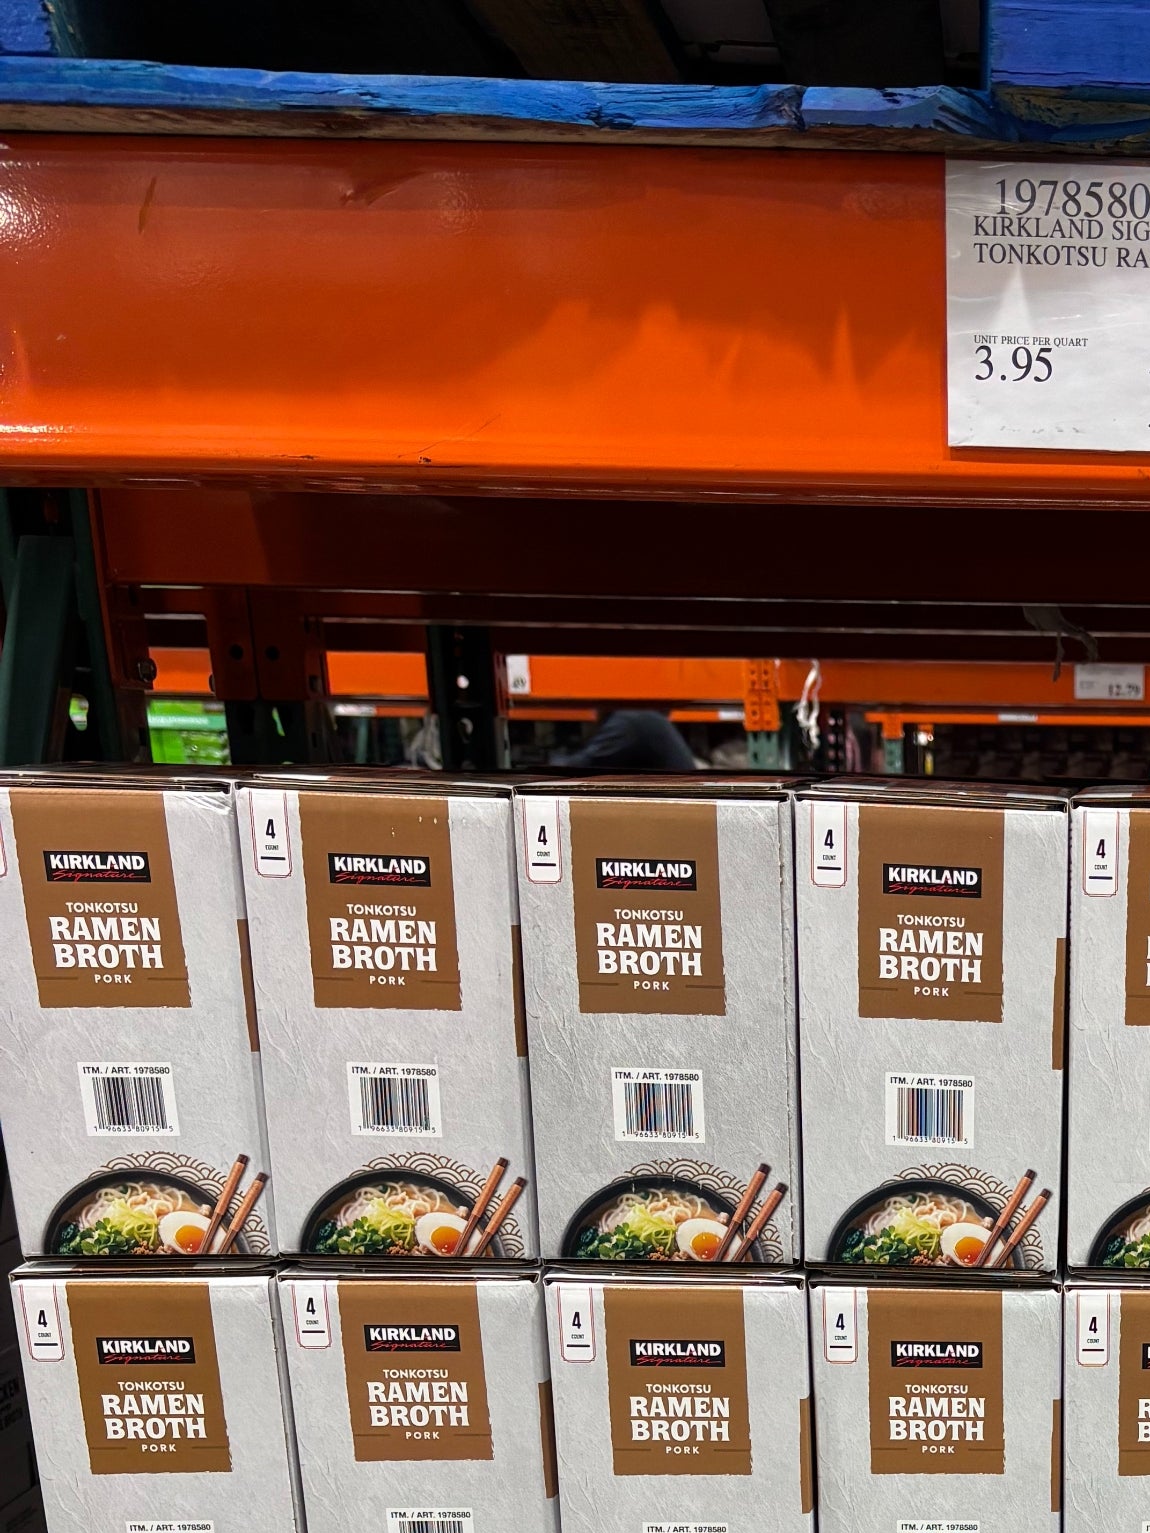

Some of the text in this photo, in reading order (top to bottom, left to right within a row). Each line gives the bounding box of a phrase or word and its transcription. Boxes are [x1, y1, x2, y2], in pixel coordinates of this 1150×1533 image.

[995, 178, 1150, 219] 1978580
[974, 216, 1103, 239] KIRKLAND
[974, 243, 1107, 266] TONKOTSU
[974, 335, 1088, 348] UNIT PRICE PER QUART
[976, 345, 1052, 382] 3.95
[266, 819, 275, 838] 4
[1096, 839, 1105, 858] 4
[334, 857, 426, 873] KIRKLAND
[336, 871, 429, 885] Signature
[347, 904, 416, 916] TONKOTSU
[330, 918, 436, 944] RAMEN
[332, 945, 437, 971] BROTH
[370, 976, 405, 985] PORK
[38, 1310, 47, 1327] 4
[103, 1340, 190, 1353] KIRKLAND
[118, 1382, 184, 1391] TONKOTSU
[101, 1394, 204, 1415] RAMEN
[105, 1418, 207, 1439] BROTH
[142, 1444, 176, 1452] PORK
